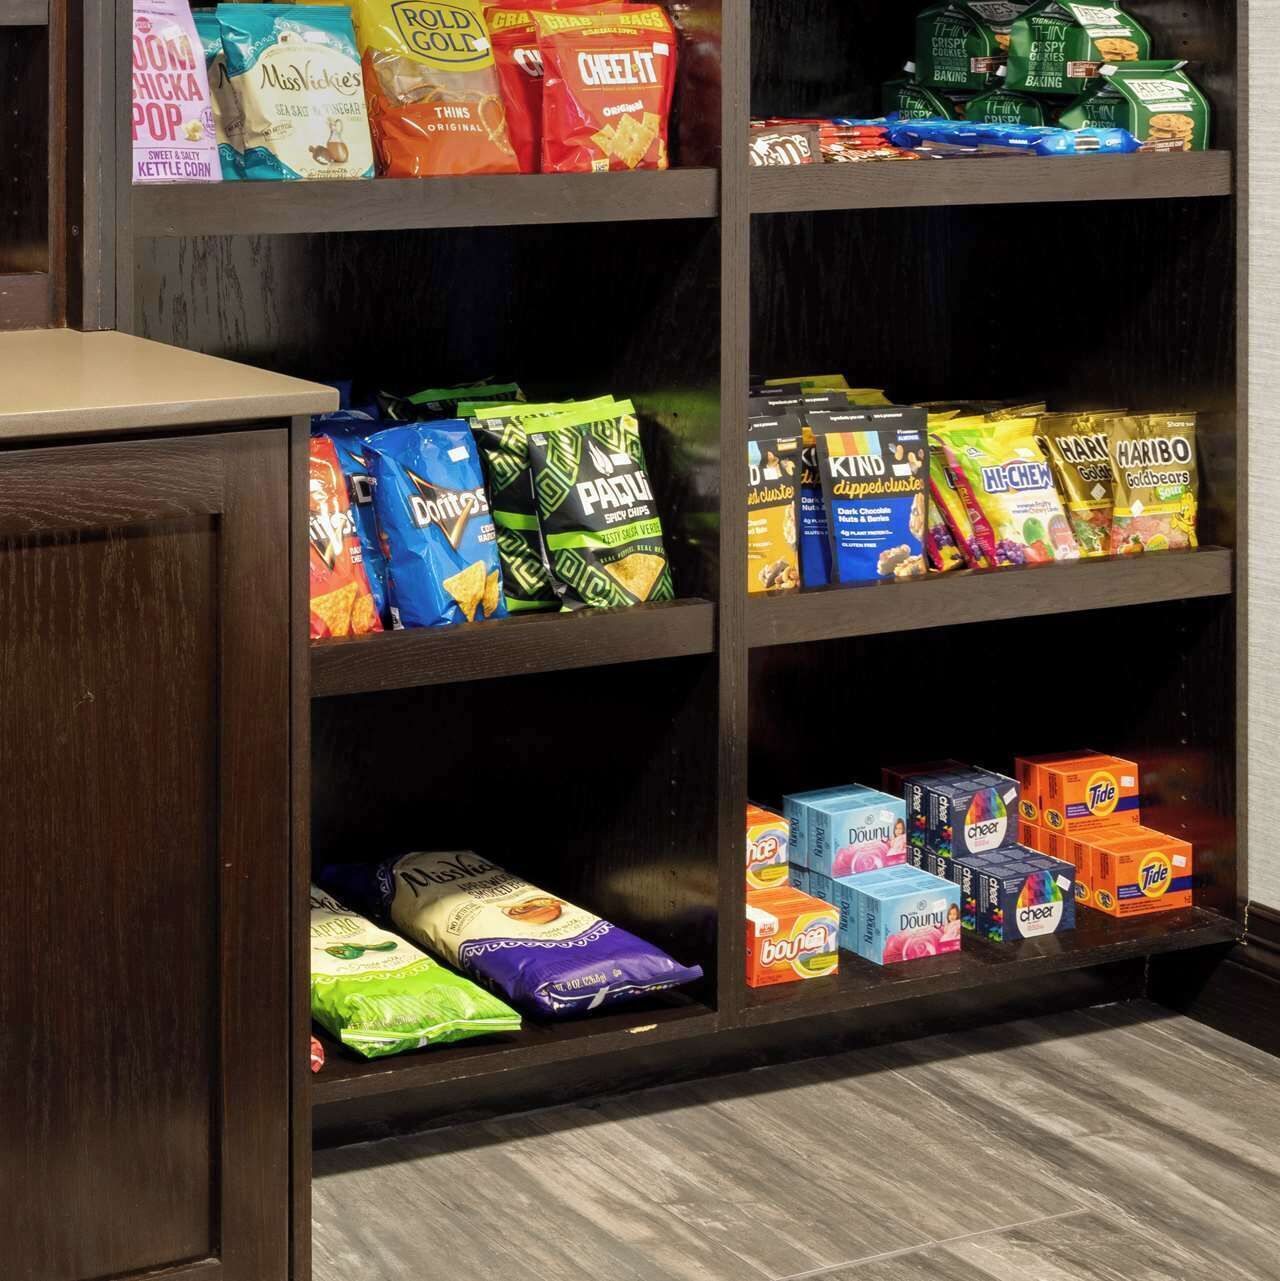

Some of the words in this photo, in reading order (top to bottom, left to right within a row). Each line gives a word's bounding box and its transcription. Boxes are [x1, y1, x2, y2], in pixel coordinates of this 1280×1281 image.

[403, 7, 471, 30] ROLD
[542, 15, 593, 29] GRAB
[619, 12, 665, 27] BAGS
[933, 23, 971, 38] THIN
[1033, 25, 1068, 41] THIN
[412, 31, 478, 53] GOLD
[931, 38, 968, 50] CRISPY
[933, 71, 968, 84] BAKING
[1024, 75, 1064, 89] BAKING
[435, 106, 471, 120] THINS
[427, 122, 484, 133] ORIGINAL
[148, 150, 174, 161] SWEET
[174, 151, 181, 160] &
[181, 150, 201, 161] SALTY
[137, 161, 184, 178] KETTLE
[185, 162, 212, 177] CORN
[1116, 435, 1192, 469] HARIBO
[828, 455, 886, 478] KIND
[1126, 470, 1191, 490] Goldbears
[410, 487, 490, 527] Doritos
[604, 511, 628, 524] SPICY
[627, 505, 651, 519] CHIPS
[837, 507, 858, 515] Dark
[859, 507, 892, 516] Chocolate
[838, 515, 860, 523] Nuts
[860, 515, 866, 523] &
[867, 515, 890, 523] Berries
[913, 785, 924, 813] cheer
[1089, 781, 1116, 811] Tide
[939, 796, 949, 824] cheer
[848, 823, 891, 846] Downy
[967, 820, 1000, 840] cheer
[814, 826, 826, 858] Downy
[962, 867, 973, 896] cheer
[1141, 863, 1169, 891] Tide
[989, 877, 999, 907] cheer
[840, 900, 850, 932] Downy
[899, 908, 945, 931] Downy
[1019, 904, 1055, 923] cheer
[864, 912, 876, 945] Downy
[760, 926, 828, 963] bounce
